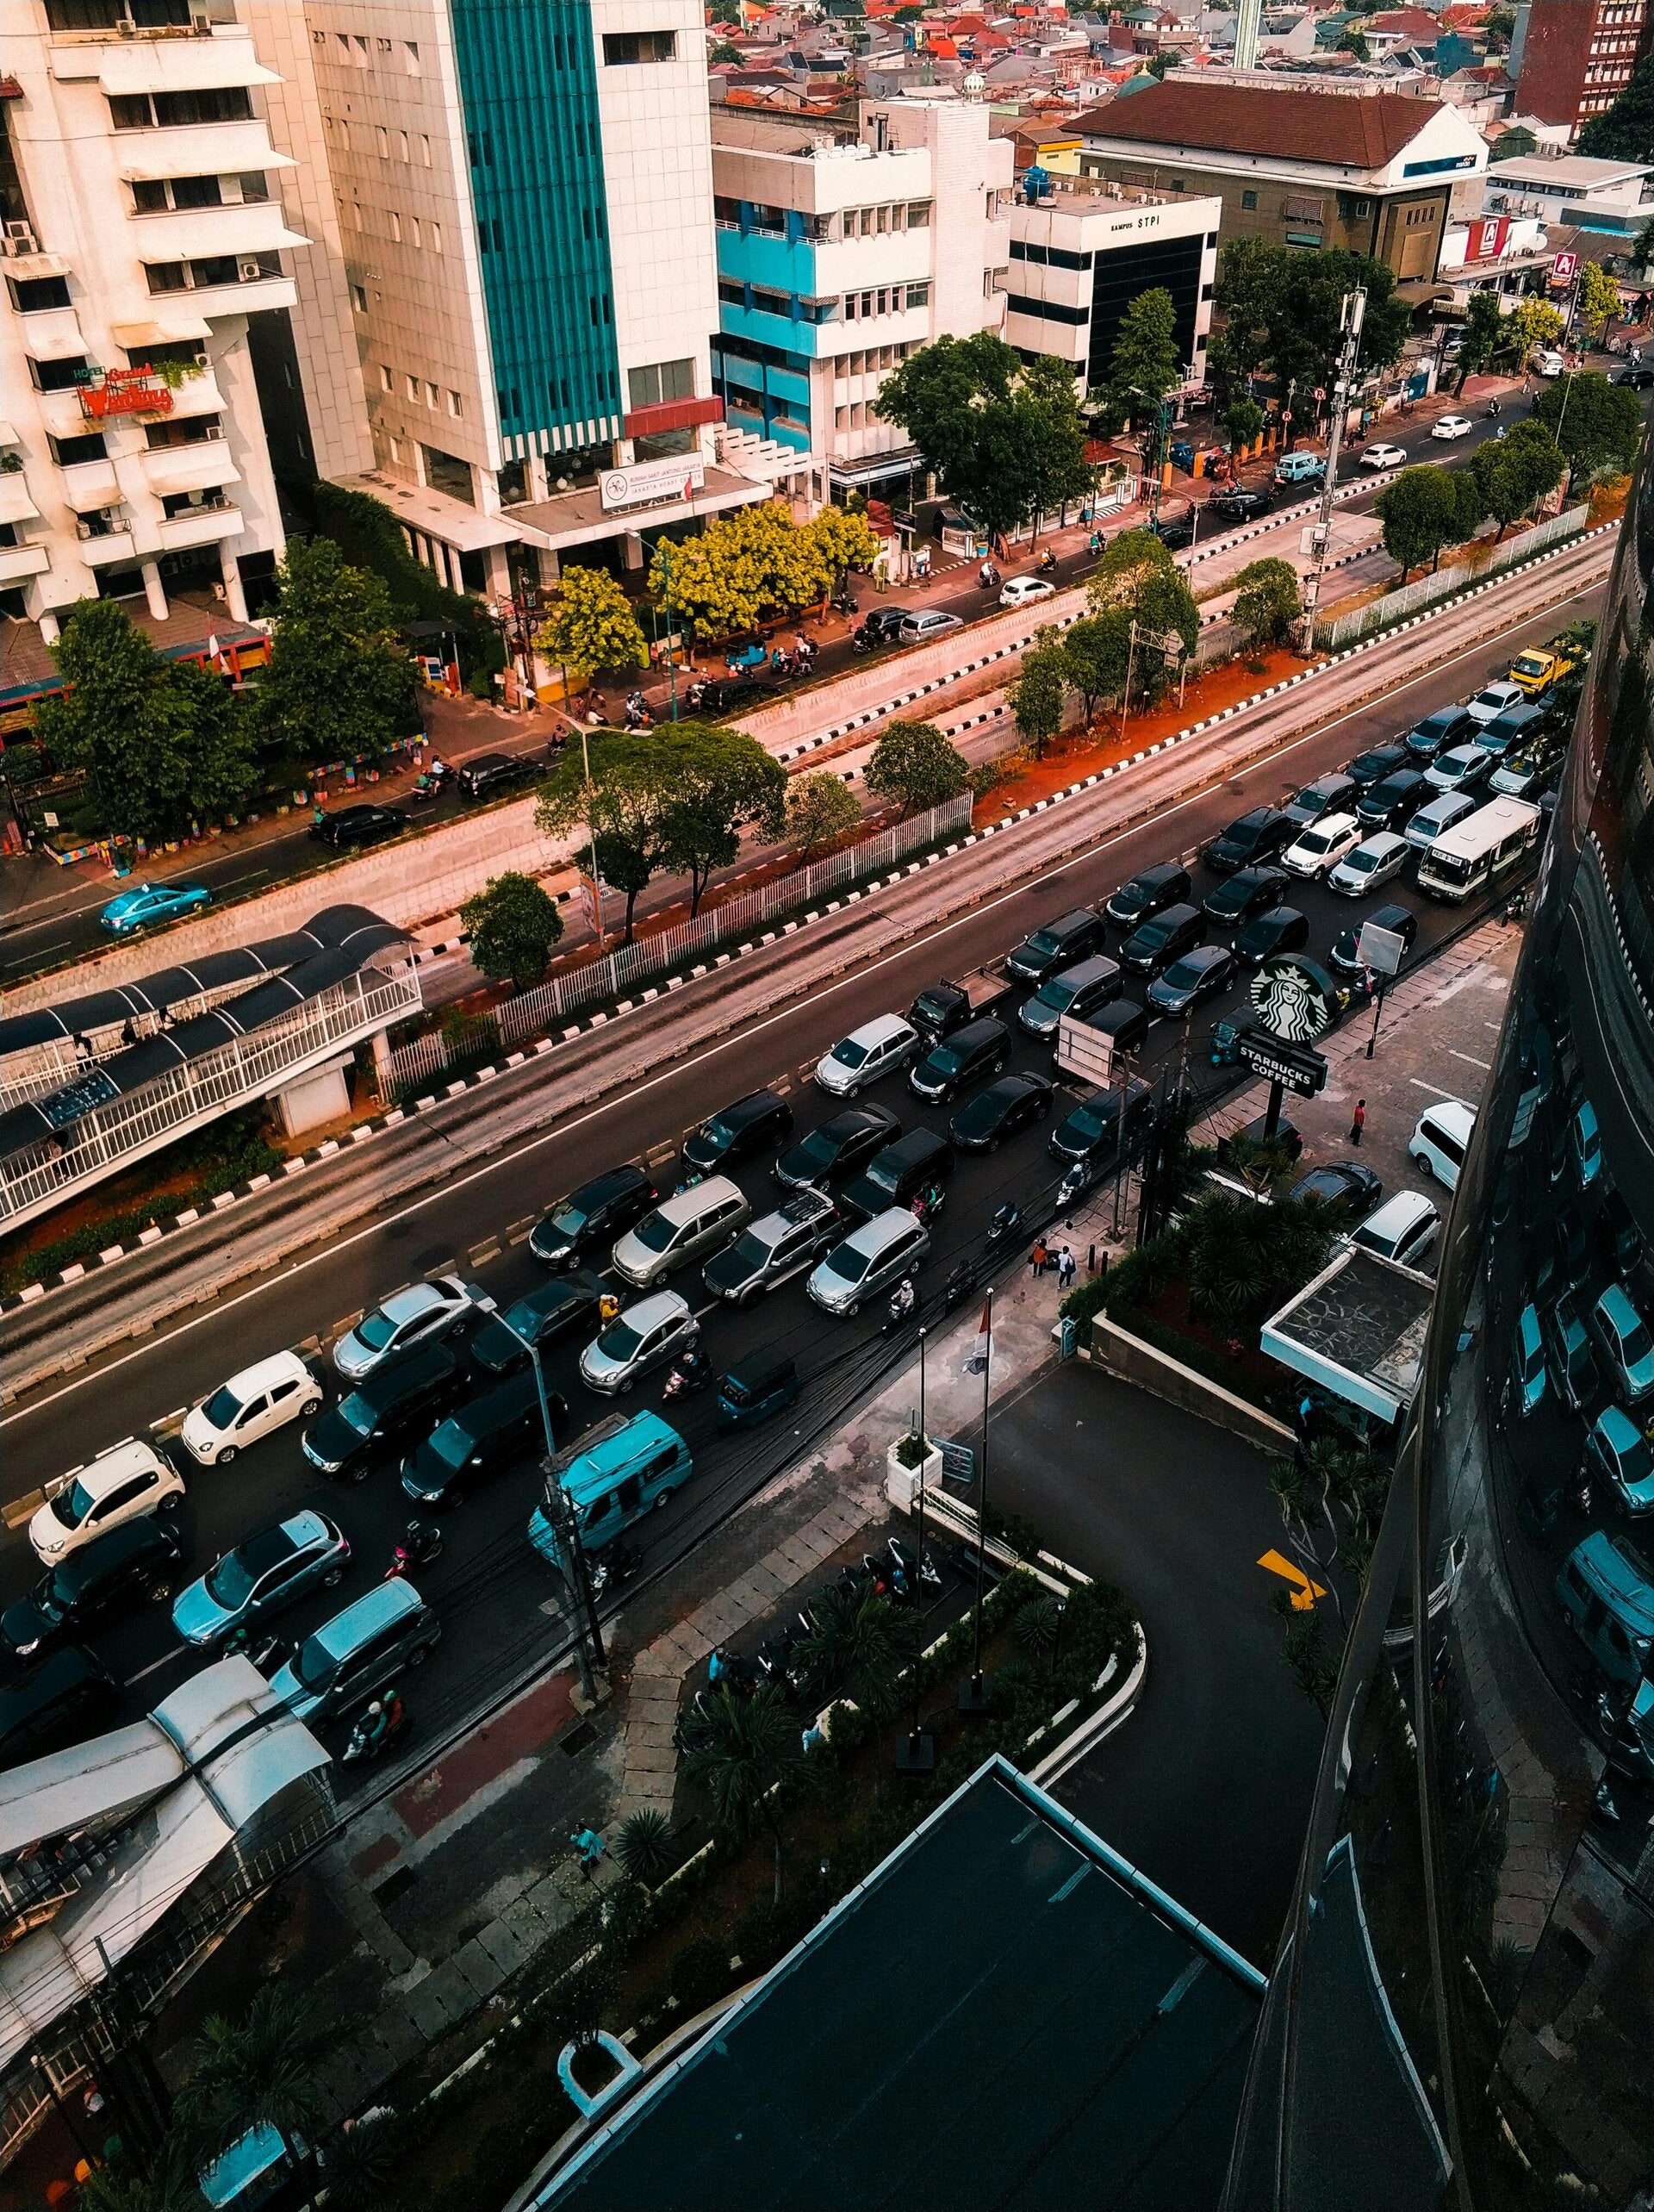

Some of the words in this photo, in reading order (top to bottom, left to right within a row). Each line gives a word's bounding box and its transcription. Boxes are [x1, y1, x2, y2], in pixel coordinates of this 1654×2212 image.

[1110, 222, 1133, 231] KAMPUS
[1138, 215, 1160, 227] STPI
[1557, 256, 1571, 273] A
[1240, 1046, 1310, 1085] STARBUCKS
[1252, 1062, 1296, 1088] COFFEE
